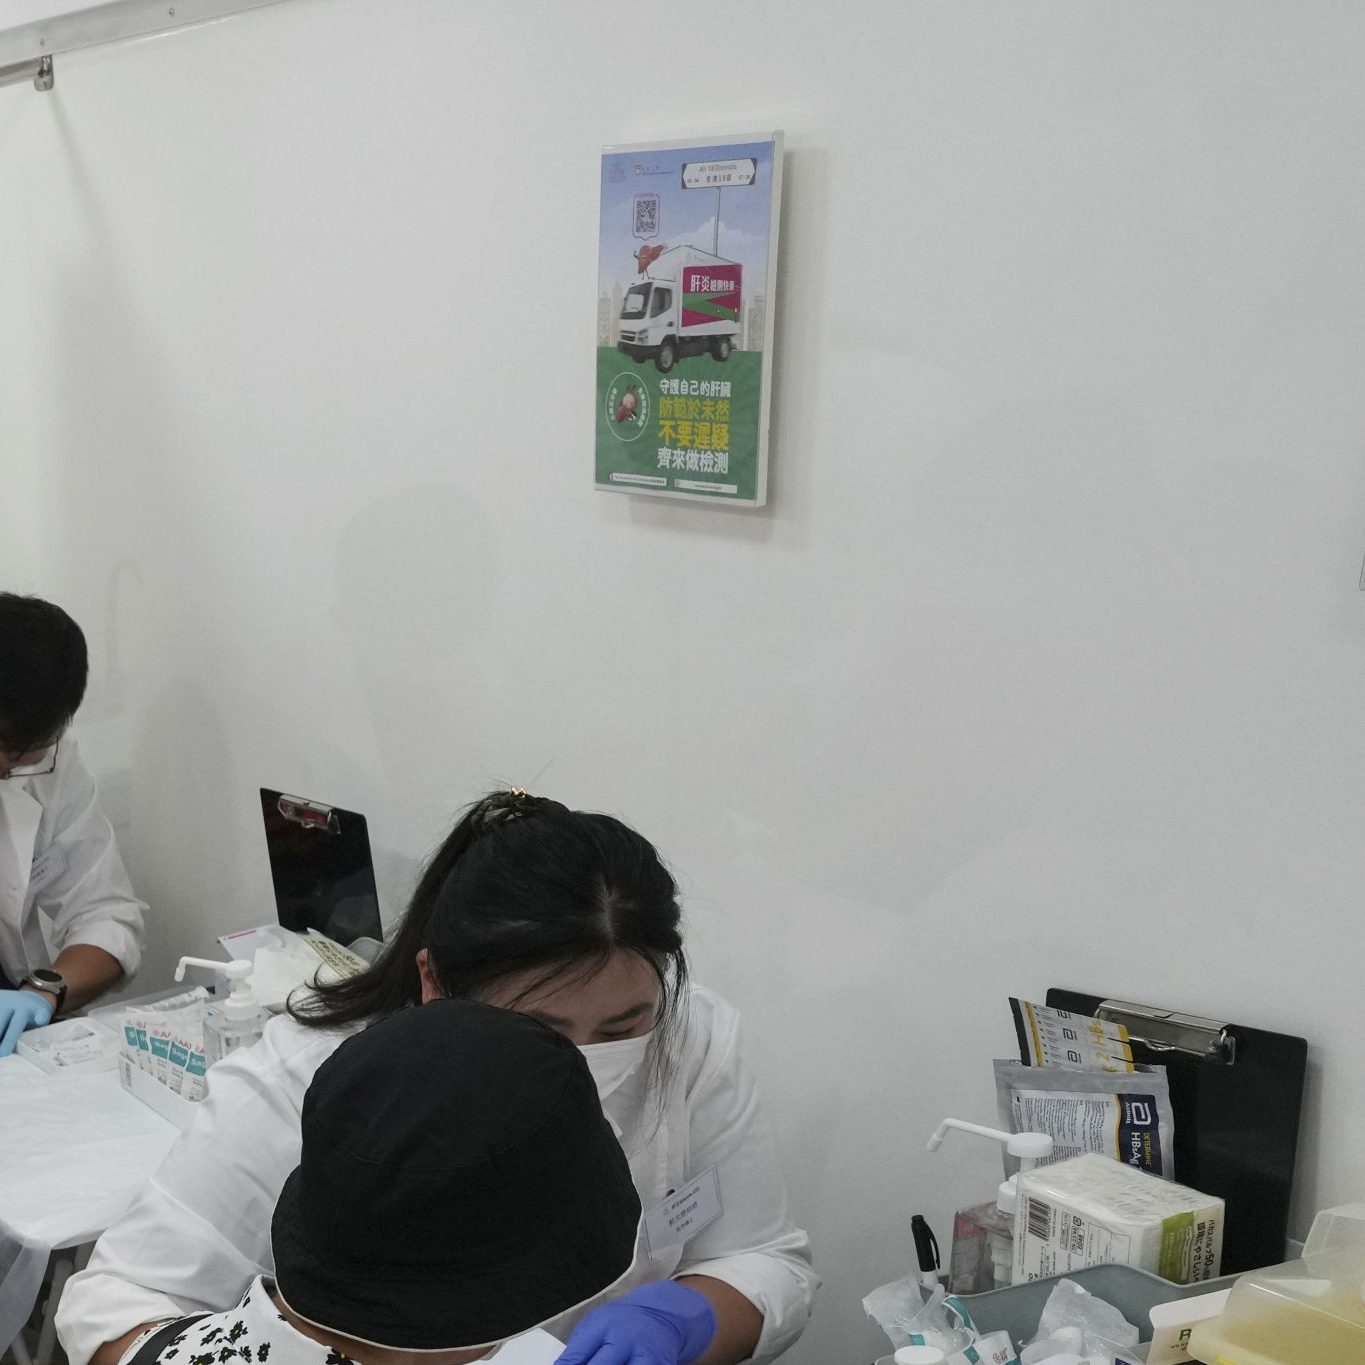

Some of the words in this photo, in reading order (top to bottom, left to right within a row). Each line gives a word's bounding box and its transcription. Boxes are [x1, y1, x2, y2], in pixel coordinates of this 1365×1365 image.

[659, 378, 732, 398] 守護自己的肝臟
[659, 395, 730, 421] 防範於未然
[657, 420, 729, 450] 不要遲疑
[657, 446, 729, 475] 齊來做檢測
[1129, 1132, 1142, 1165] HBsAg
